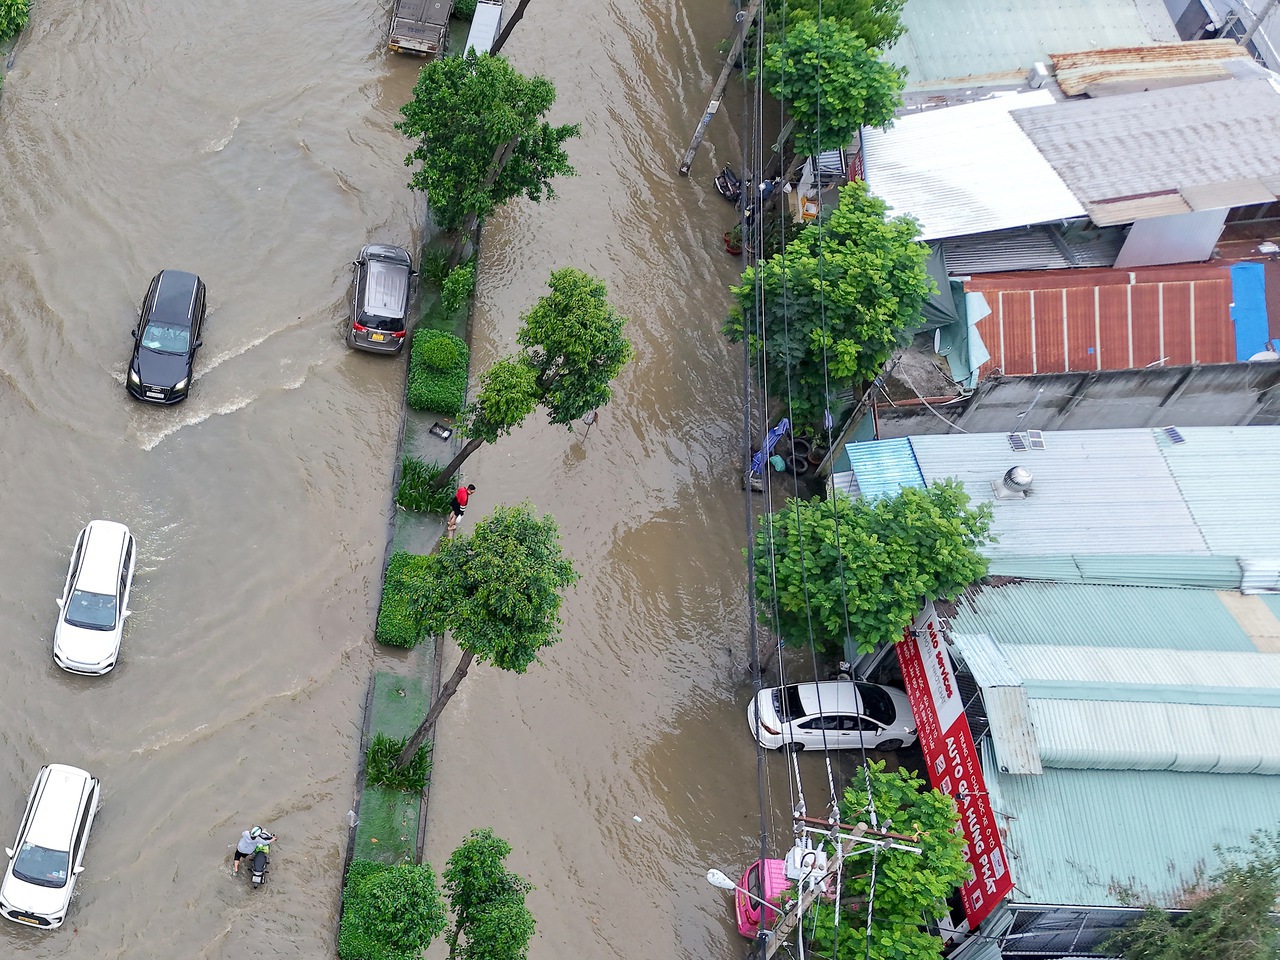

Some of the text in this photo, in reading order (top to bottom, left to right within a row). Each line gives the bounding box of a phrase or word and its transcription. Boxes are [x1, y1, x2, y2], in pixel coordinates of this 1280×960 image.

[927, 621, 954, 699] auto services
[945, 736, 996, 895] AUTO GIA HƯNG PHÁT
[958, 731, 995, 847] TRUNG TÂM CHĂM SÓC XE Ô TÔ
